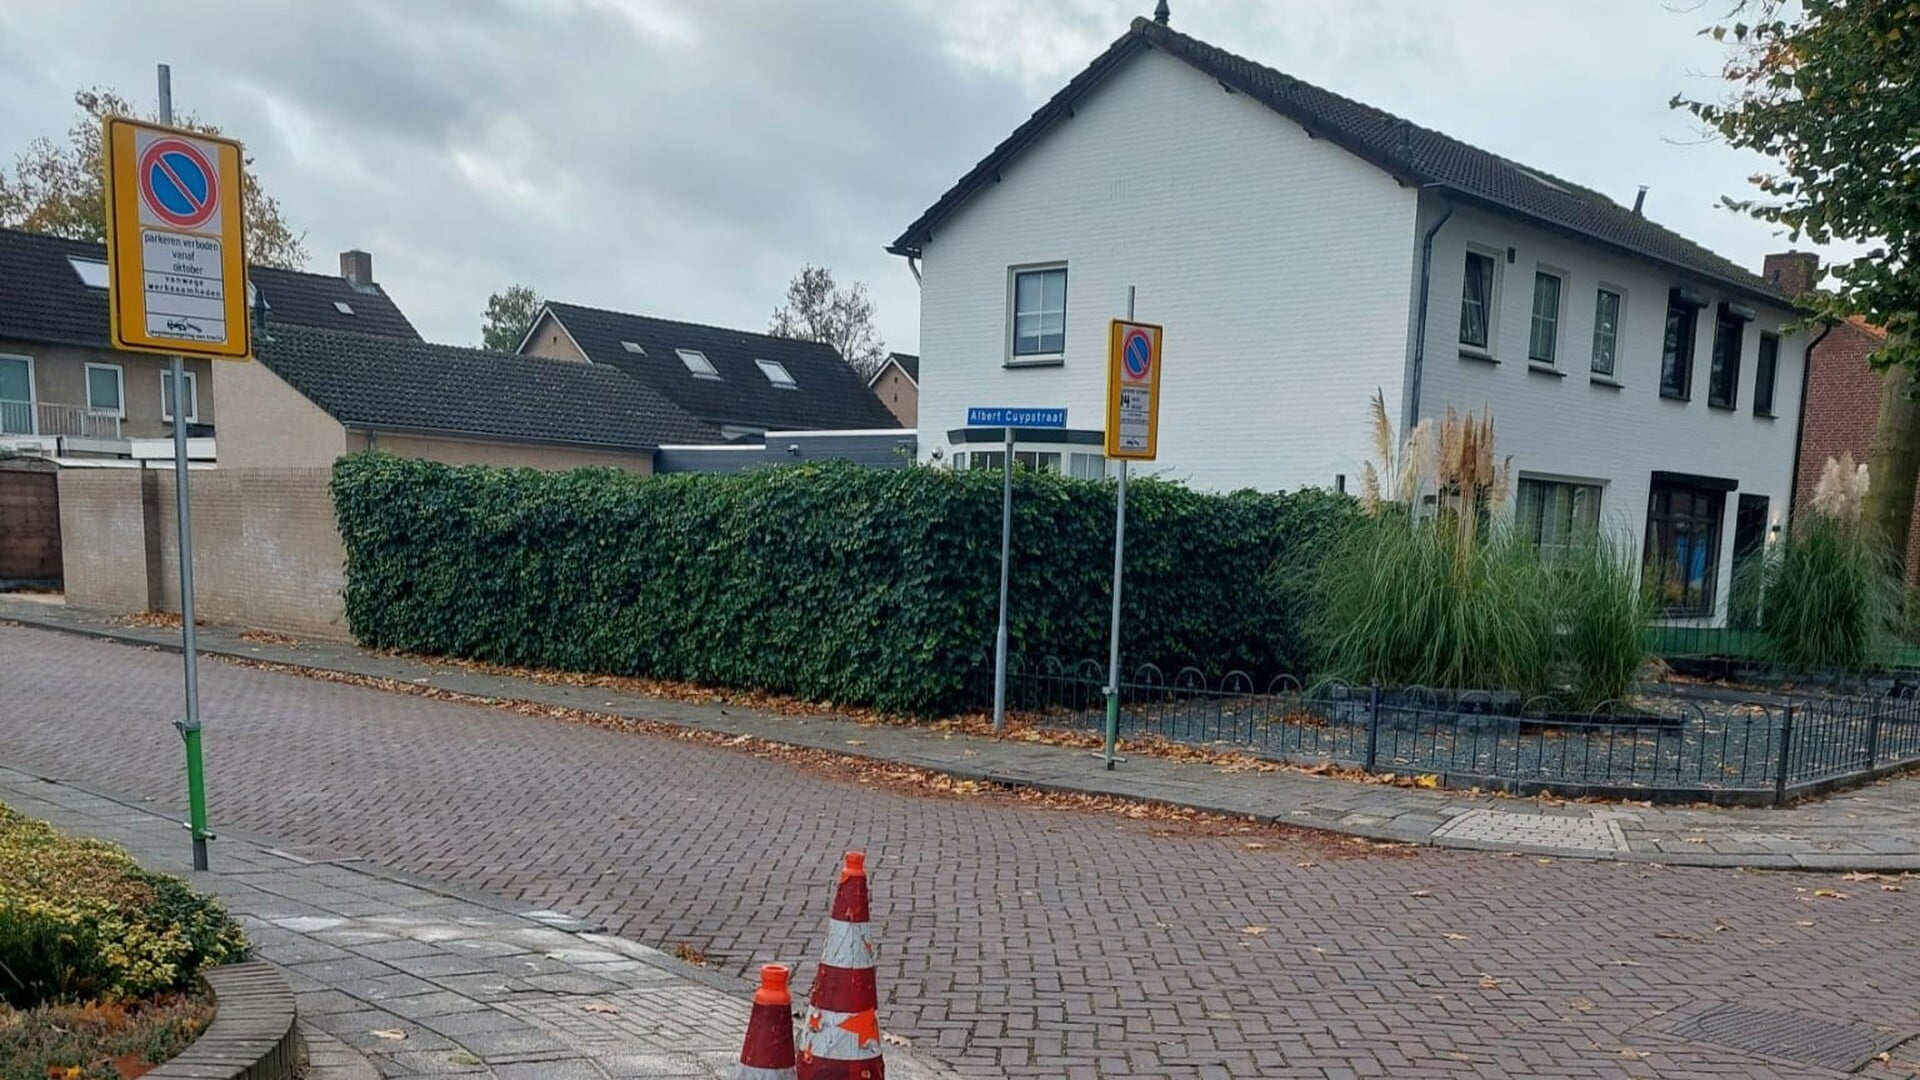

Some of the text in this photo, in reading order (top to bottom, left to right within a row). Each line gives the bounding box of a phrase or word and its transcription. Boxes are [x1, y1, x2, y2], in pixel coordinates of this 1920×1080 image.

[144, 233, 219, 252] parkeren verboden
[172, 251, 195, 261] vanaf
[173, 263, 203, 275] oktober
[165, 276, 204, 287] vanwege
[148, 283, 222, 297] werkzaamheden
[970, 409, 1064, 424] Albert Cuypstraat
